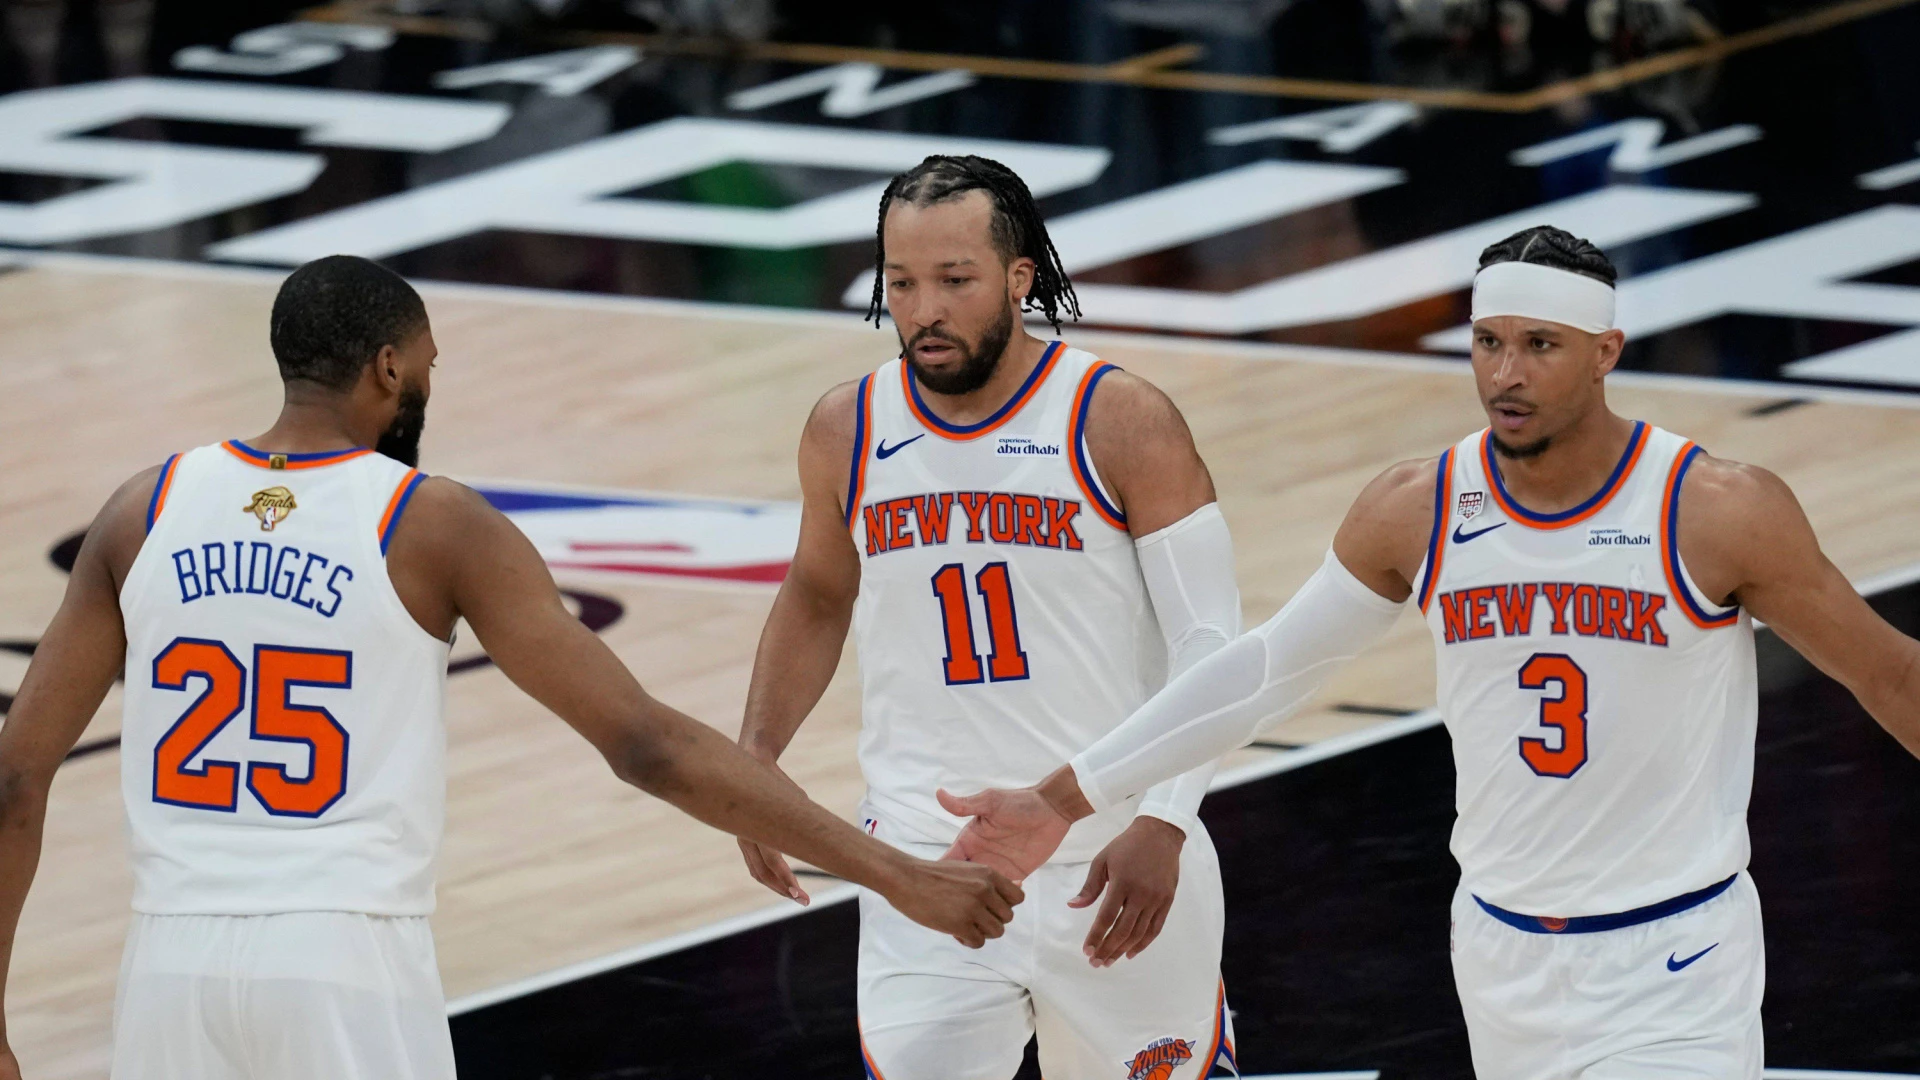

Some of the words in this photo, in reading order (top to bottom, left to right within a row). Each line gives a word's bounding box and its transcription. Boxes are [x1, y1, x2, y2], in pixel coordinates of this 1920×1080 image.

[172, 21, 982, 119] SAN
[1208, 100, 1920, 190] AN
[997, 444, 1021, 454] abu
[1023, 444, 1060, 455] dhabi
[863, 492, 953, 557] NEW
[957, 492, 1084, 551] YORK
[1460, 494, 1481, 502] USA
[1588, 535, 1612, 545] abu
[1614, 534, 1651, 545] dhabi
[172, 541, 354, 618] BRIDGES
[930, 561, 1030, 686] 11
[1439, 582, 1538, 646] NEW
[1542, 582, 1669, 647] YORK
[151, 636, 353, 818] 25
[1518, 652, 1588, 779] 3
[1127, 1039, 1192, 1079] KNICKS
